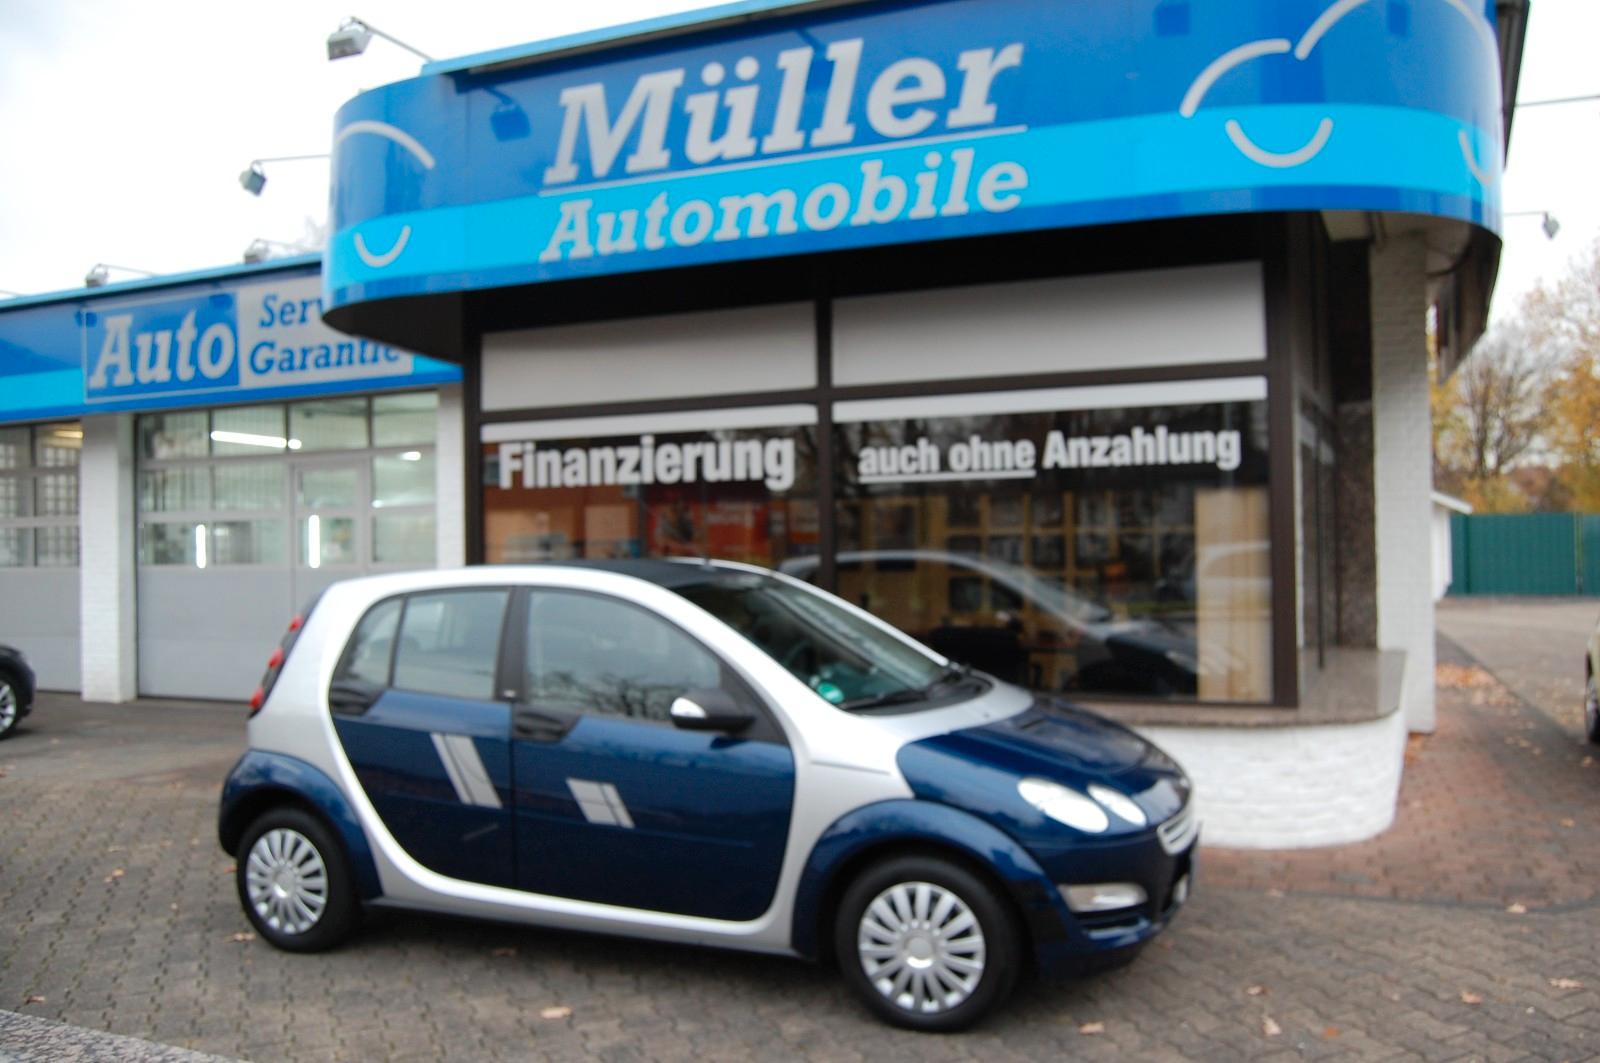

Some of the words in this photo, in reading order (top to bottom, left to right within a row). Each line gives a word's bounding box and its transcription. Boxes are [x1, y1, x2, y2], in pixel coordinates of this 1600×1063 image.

[543, 38, 1023, 186] Müller
[538, 147, 1029, 263] Automobile
[89, 310, 236, 389] Auto
[499, 435, 796, 492] Finanzierung
[858, 437, 940, 476] auch
[948, 434, 1036, 472] ohne
[1042, 425, 1242, 471] Anzahlung
